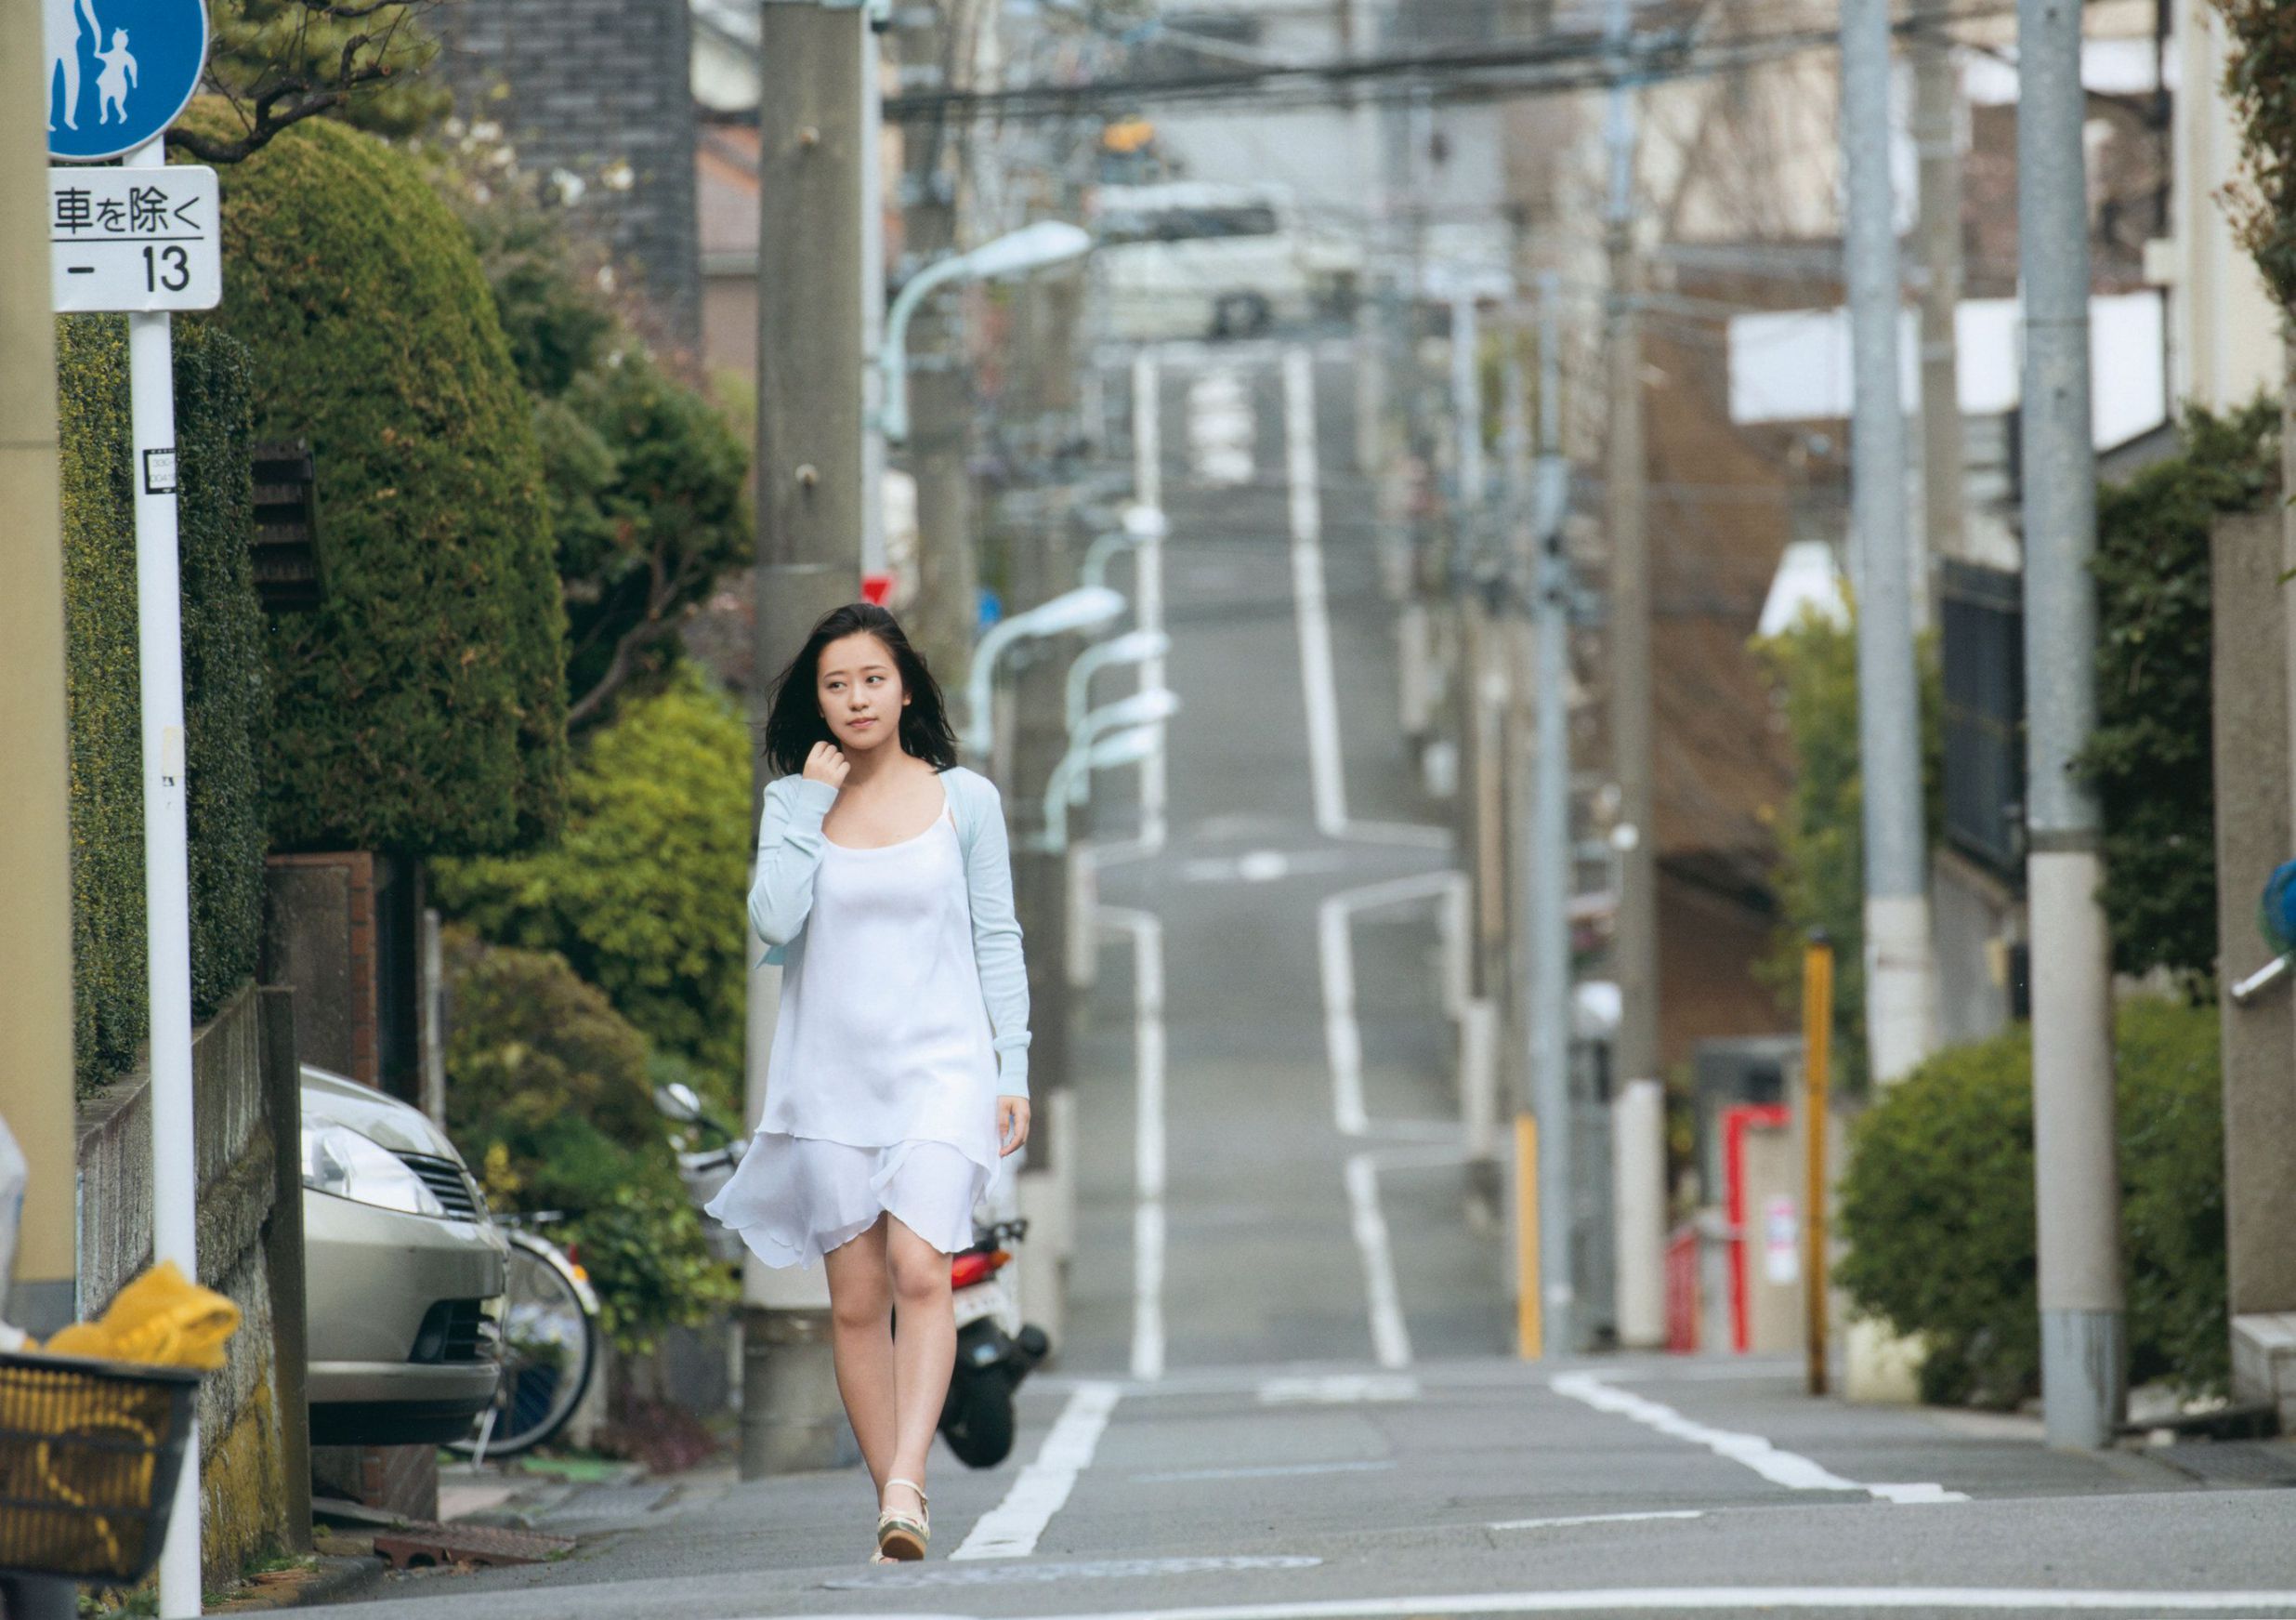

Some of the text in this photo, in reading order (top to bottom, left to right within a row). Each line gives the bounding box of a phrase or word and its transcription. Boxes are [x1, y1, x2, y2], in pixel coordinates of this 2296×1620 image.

[54, 186, 201, 234] 車を除く
[142, 245, 190, 293] 13
